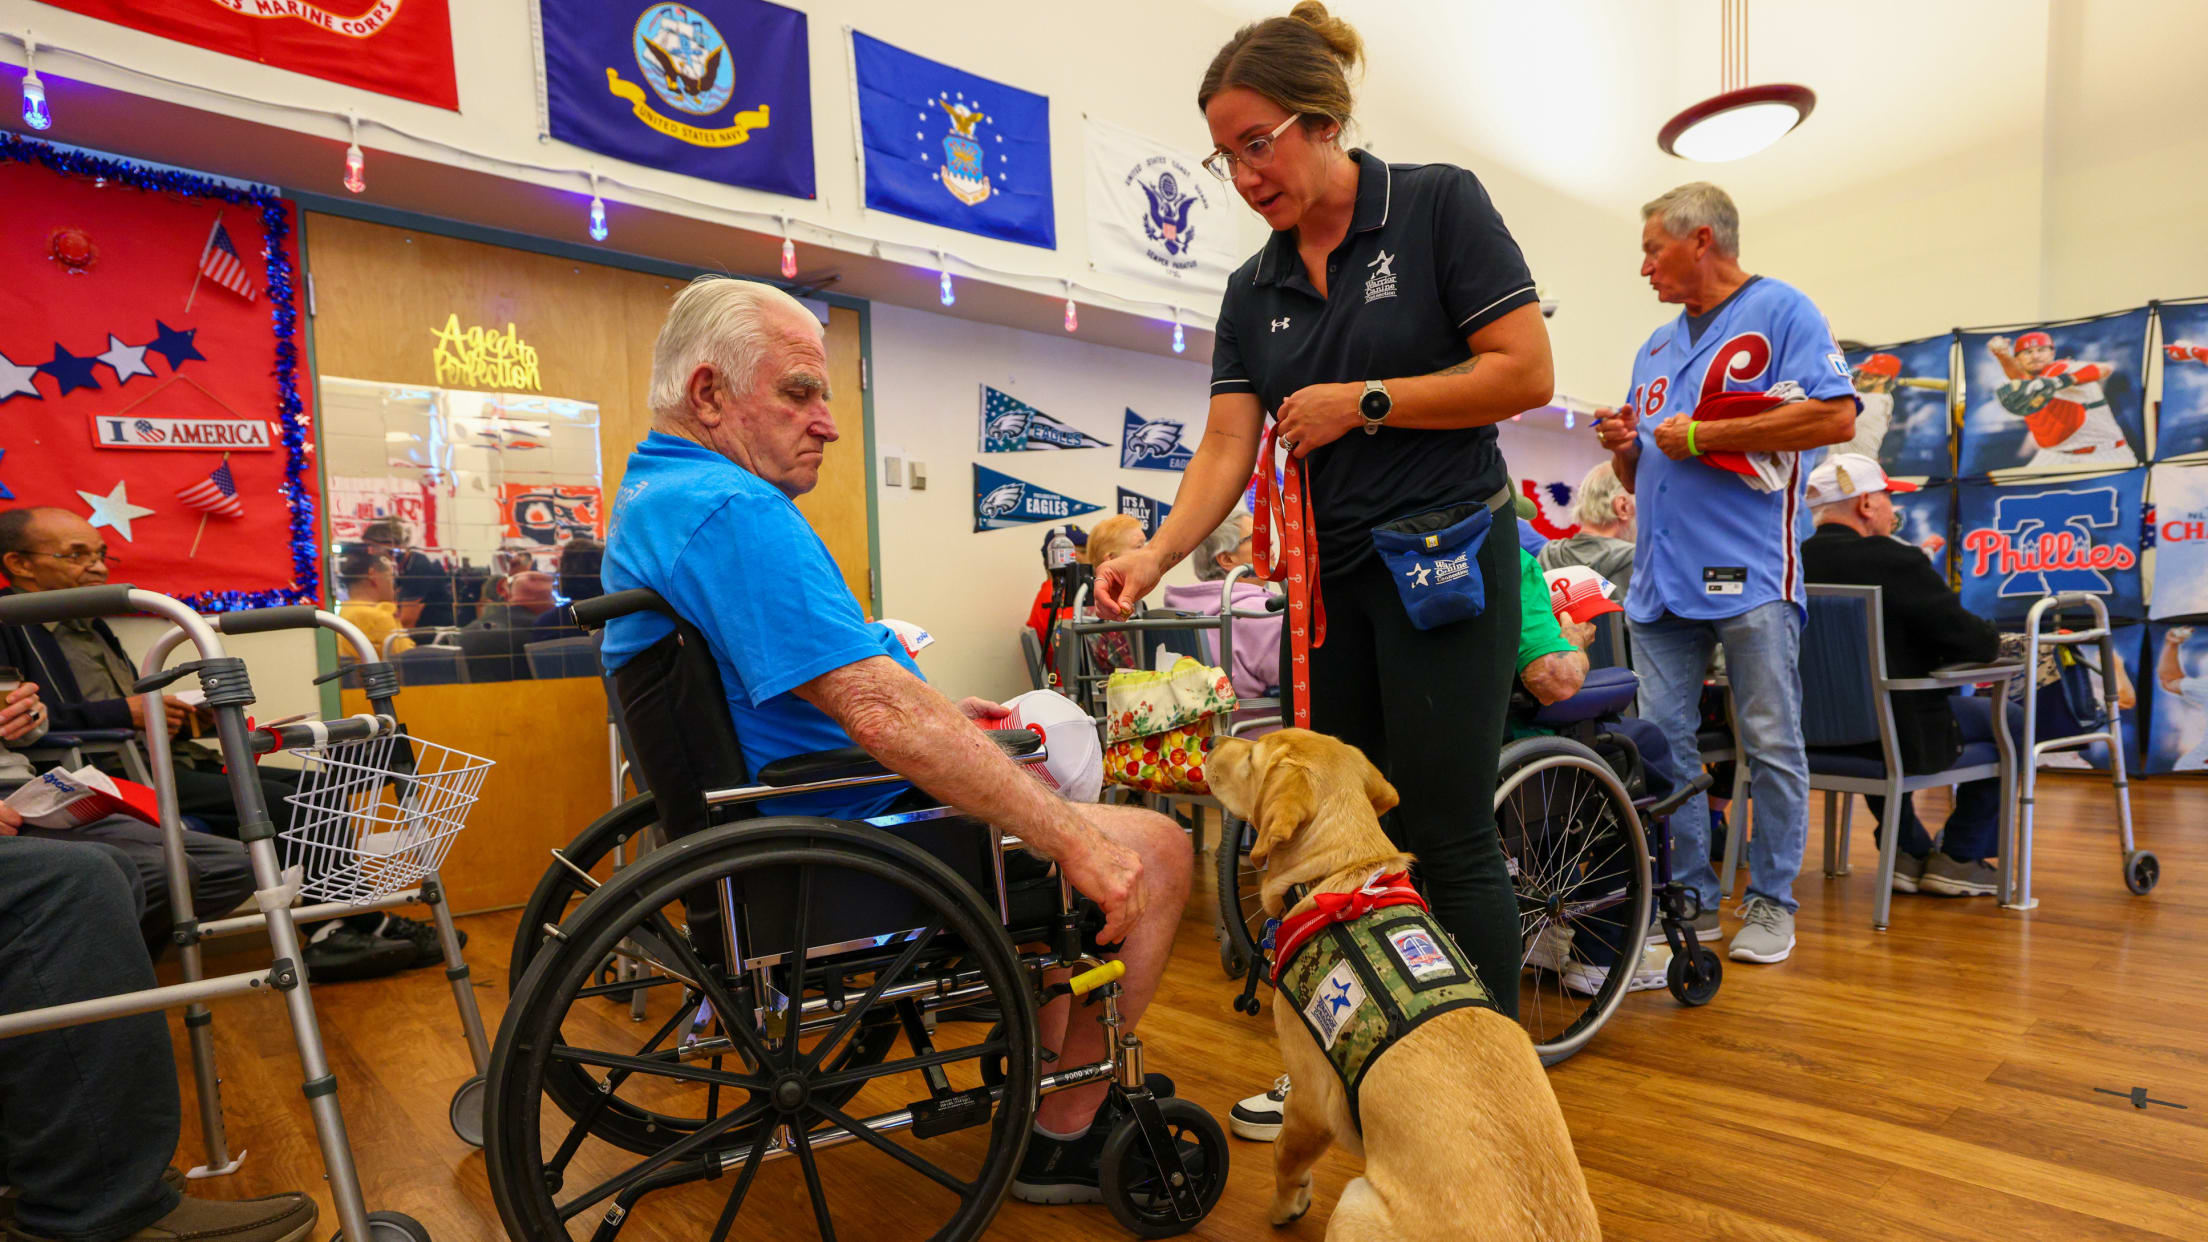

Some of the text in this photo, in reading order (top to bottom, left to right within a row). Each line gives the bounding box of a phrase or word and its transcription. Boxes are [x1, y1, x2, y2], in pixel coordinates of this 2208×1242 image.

[257, 0, 392, 34] MARINE CORPS
[639, 105, 742, 143] UNITED STATES NAVY
[430, 313, 519, 362] Aged
[433, 347, 543, 392] Perfection
[106, 420, 264, 445] I AMERICA
[1033, 425, 1083, 446] EAGLES
[1026, 498, 1069, 516] EAGLES
[1122, 496, 1146, 508] IT'S A
[1122, 506, 1151, 519] PHILLY
[1963, 528, 2137, 576] Phillies
[1064, 1069, 1083, 1080] 9000
